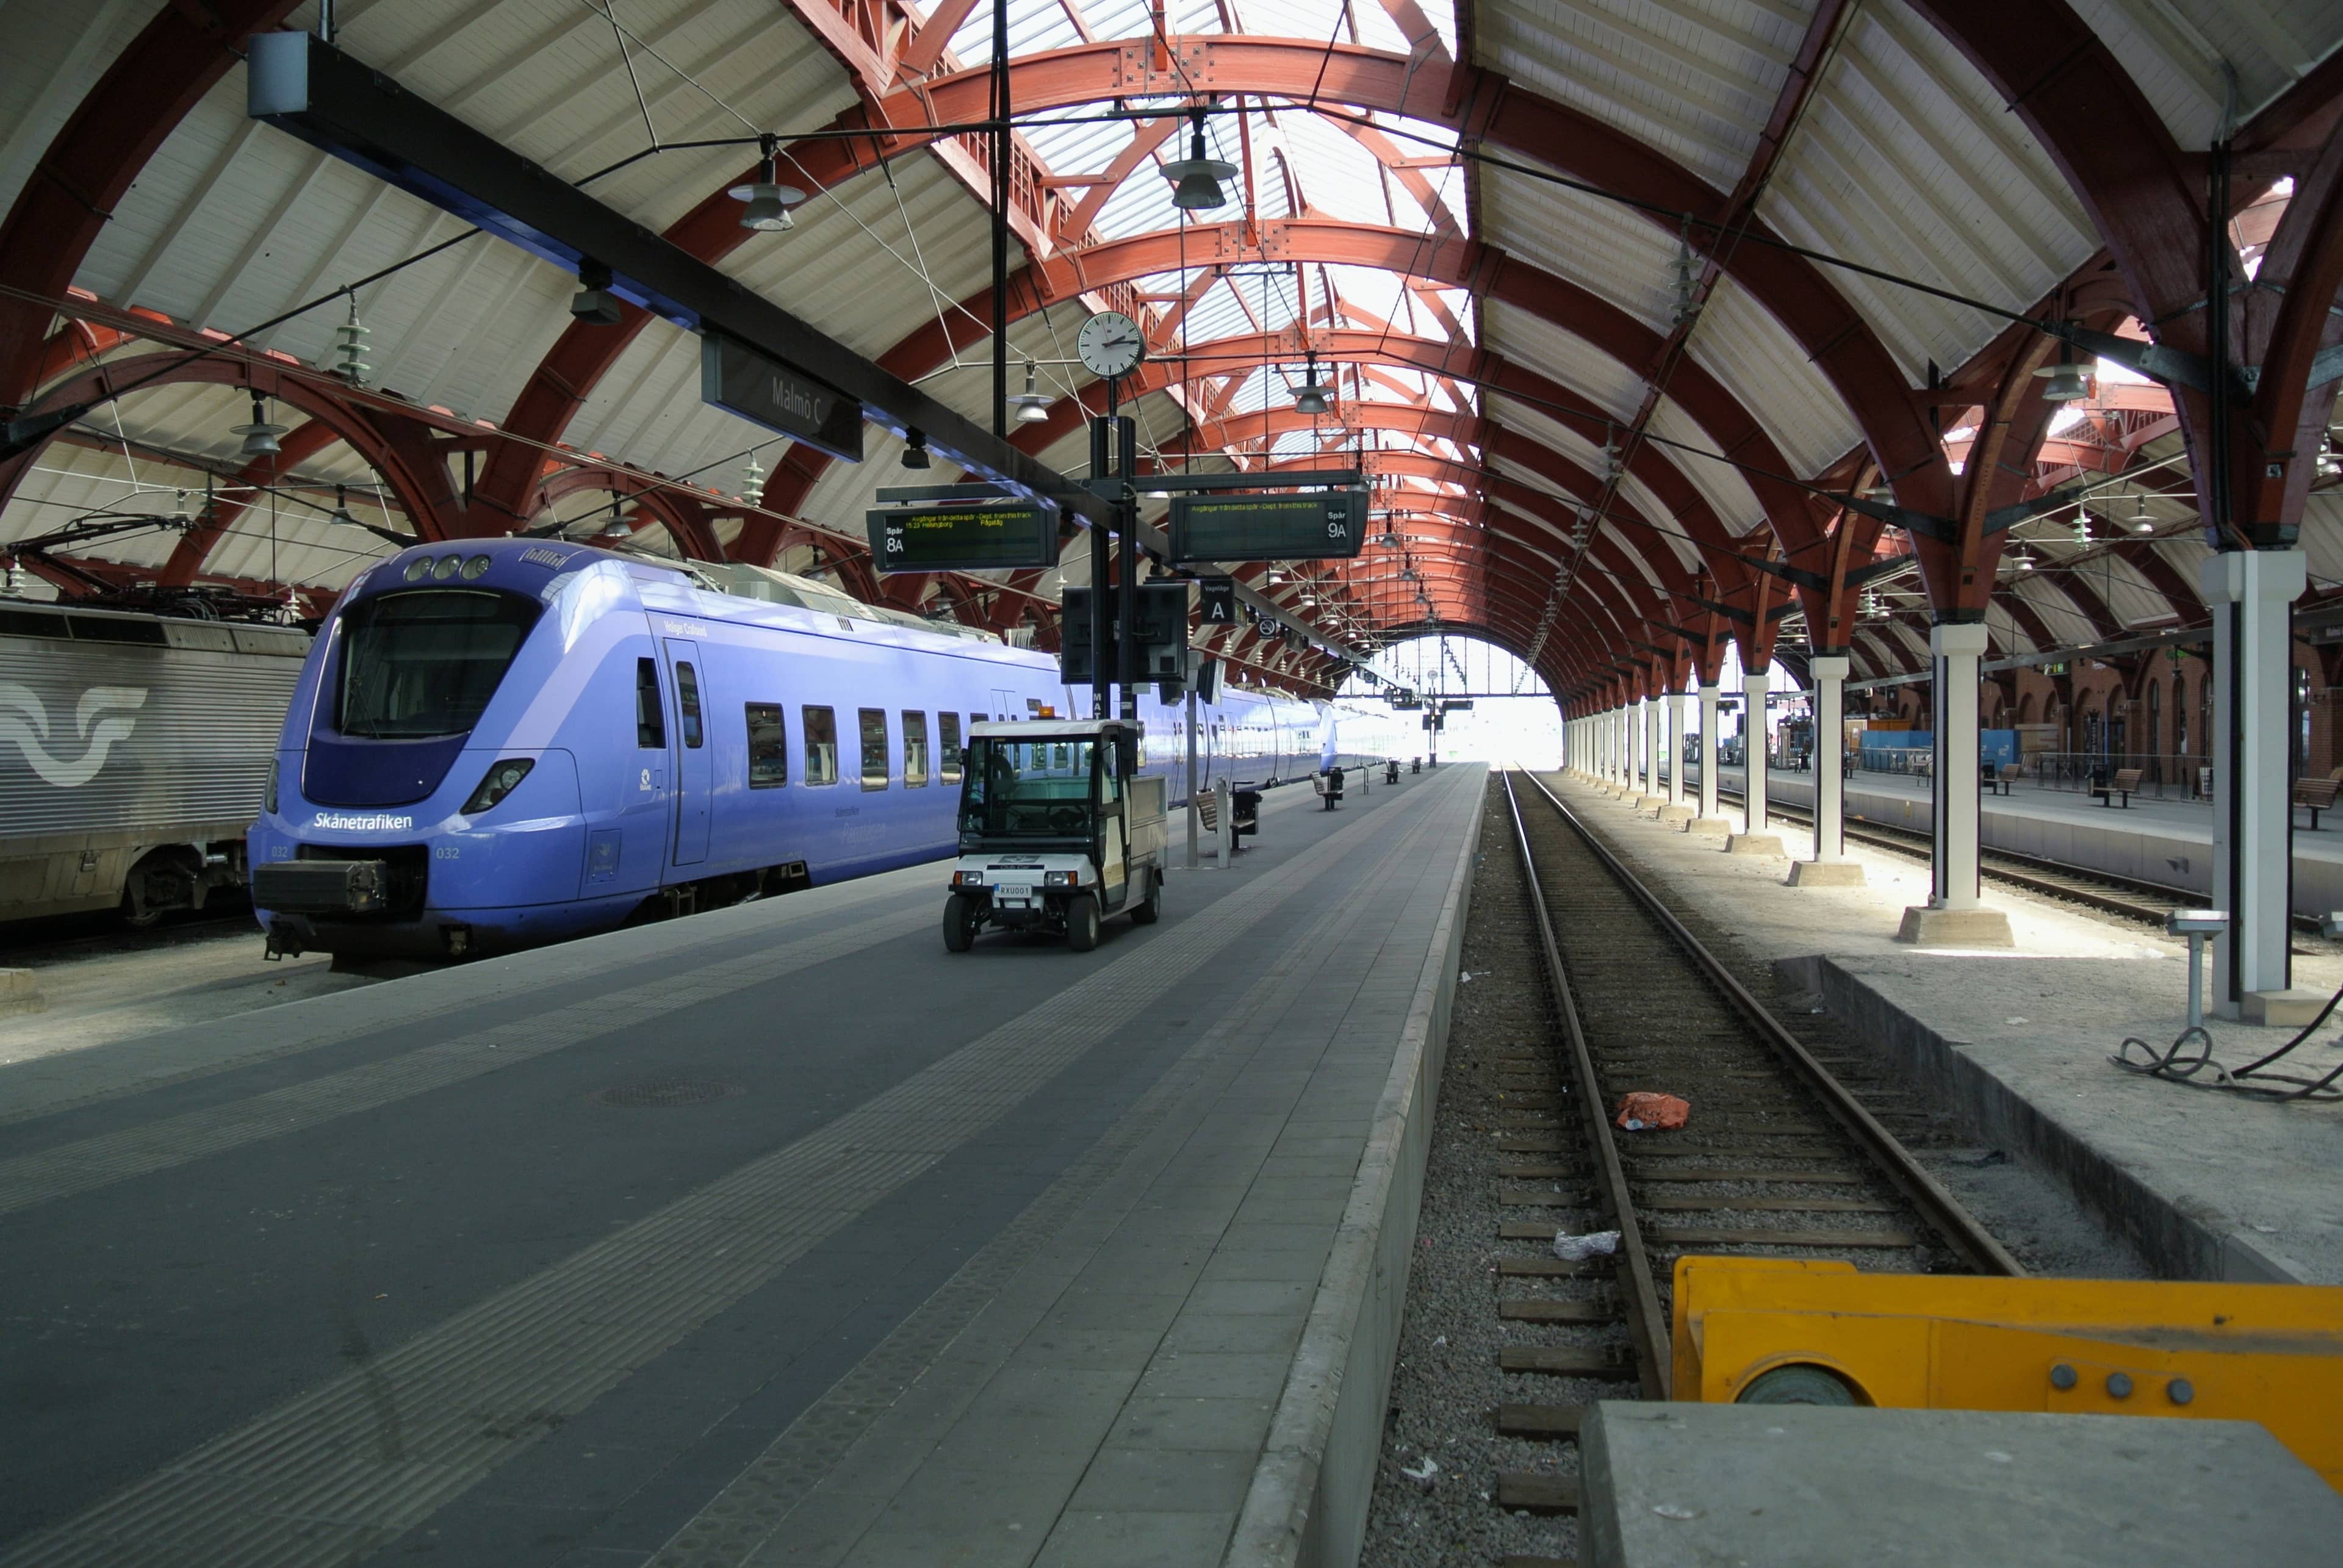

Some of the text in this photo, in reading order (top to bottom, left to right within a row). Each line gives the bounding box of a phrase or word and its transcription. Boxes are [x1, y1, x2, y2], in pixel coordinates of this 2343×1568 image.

[773, 376, 821, 425] Malmö C
[1328, 511, 1346, 520] Spår
[886, 527, 903, 536] Spår
[1328, 522, 1347, 538] 9A
[887, 538, 904, 552] 8A
[1211, 602, 1225, 619] A
[314, 812, 412, 830] Skånetrafiken
[272, 846, 287, 857] 032
[436, 847, 459, 859] 032
